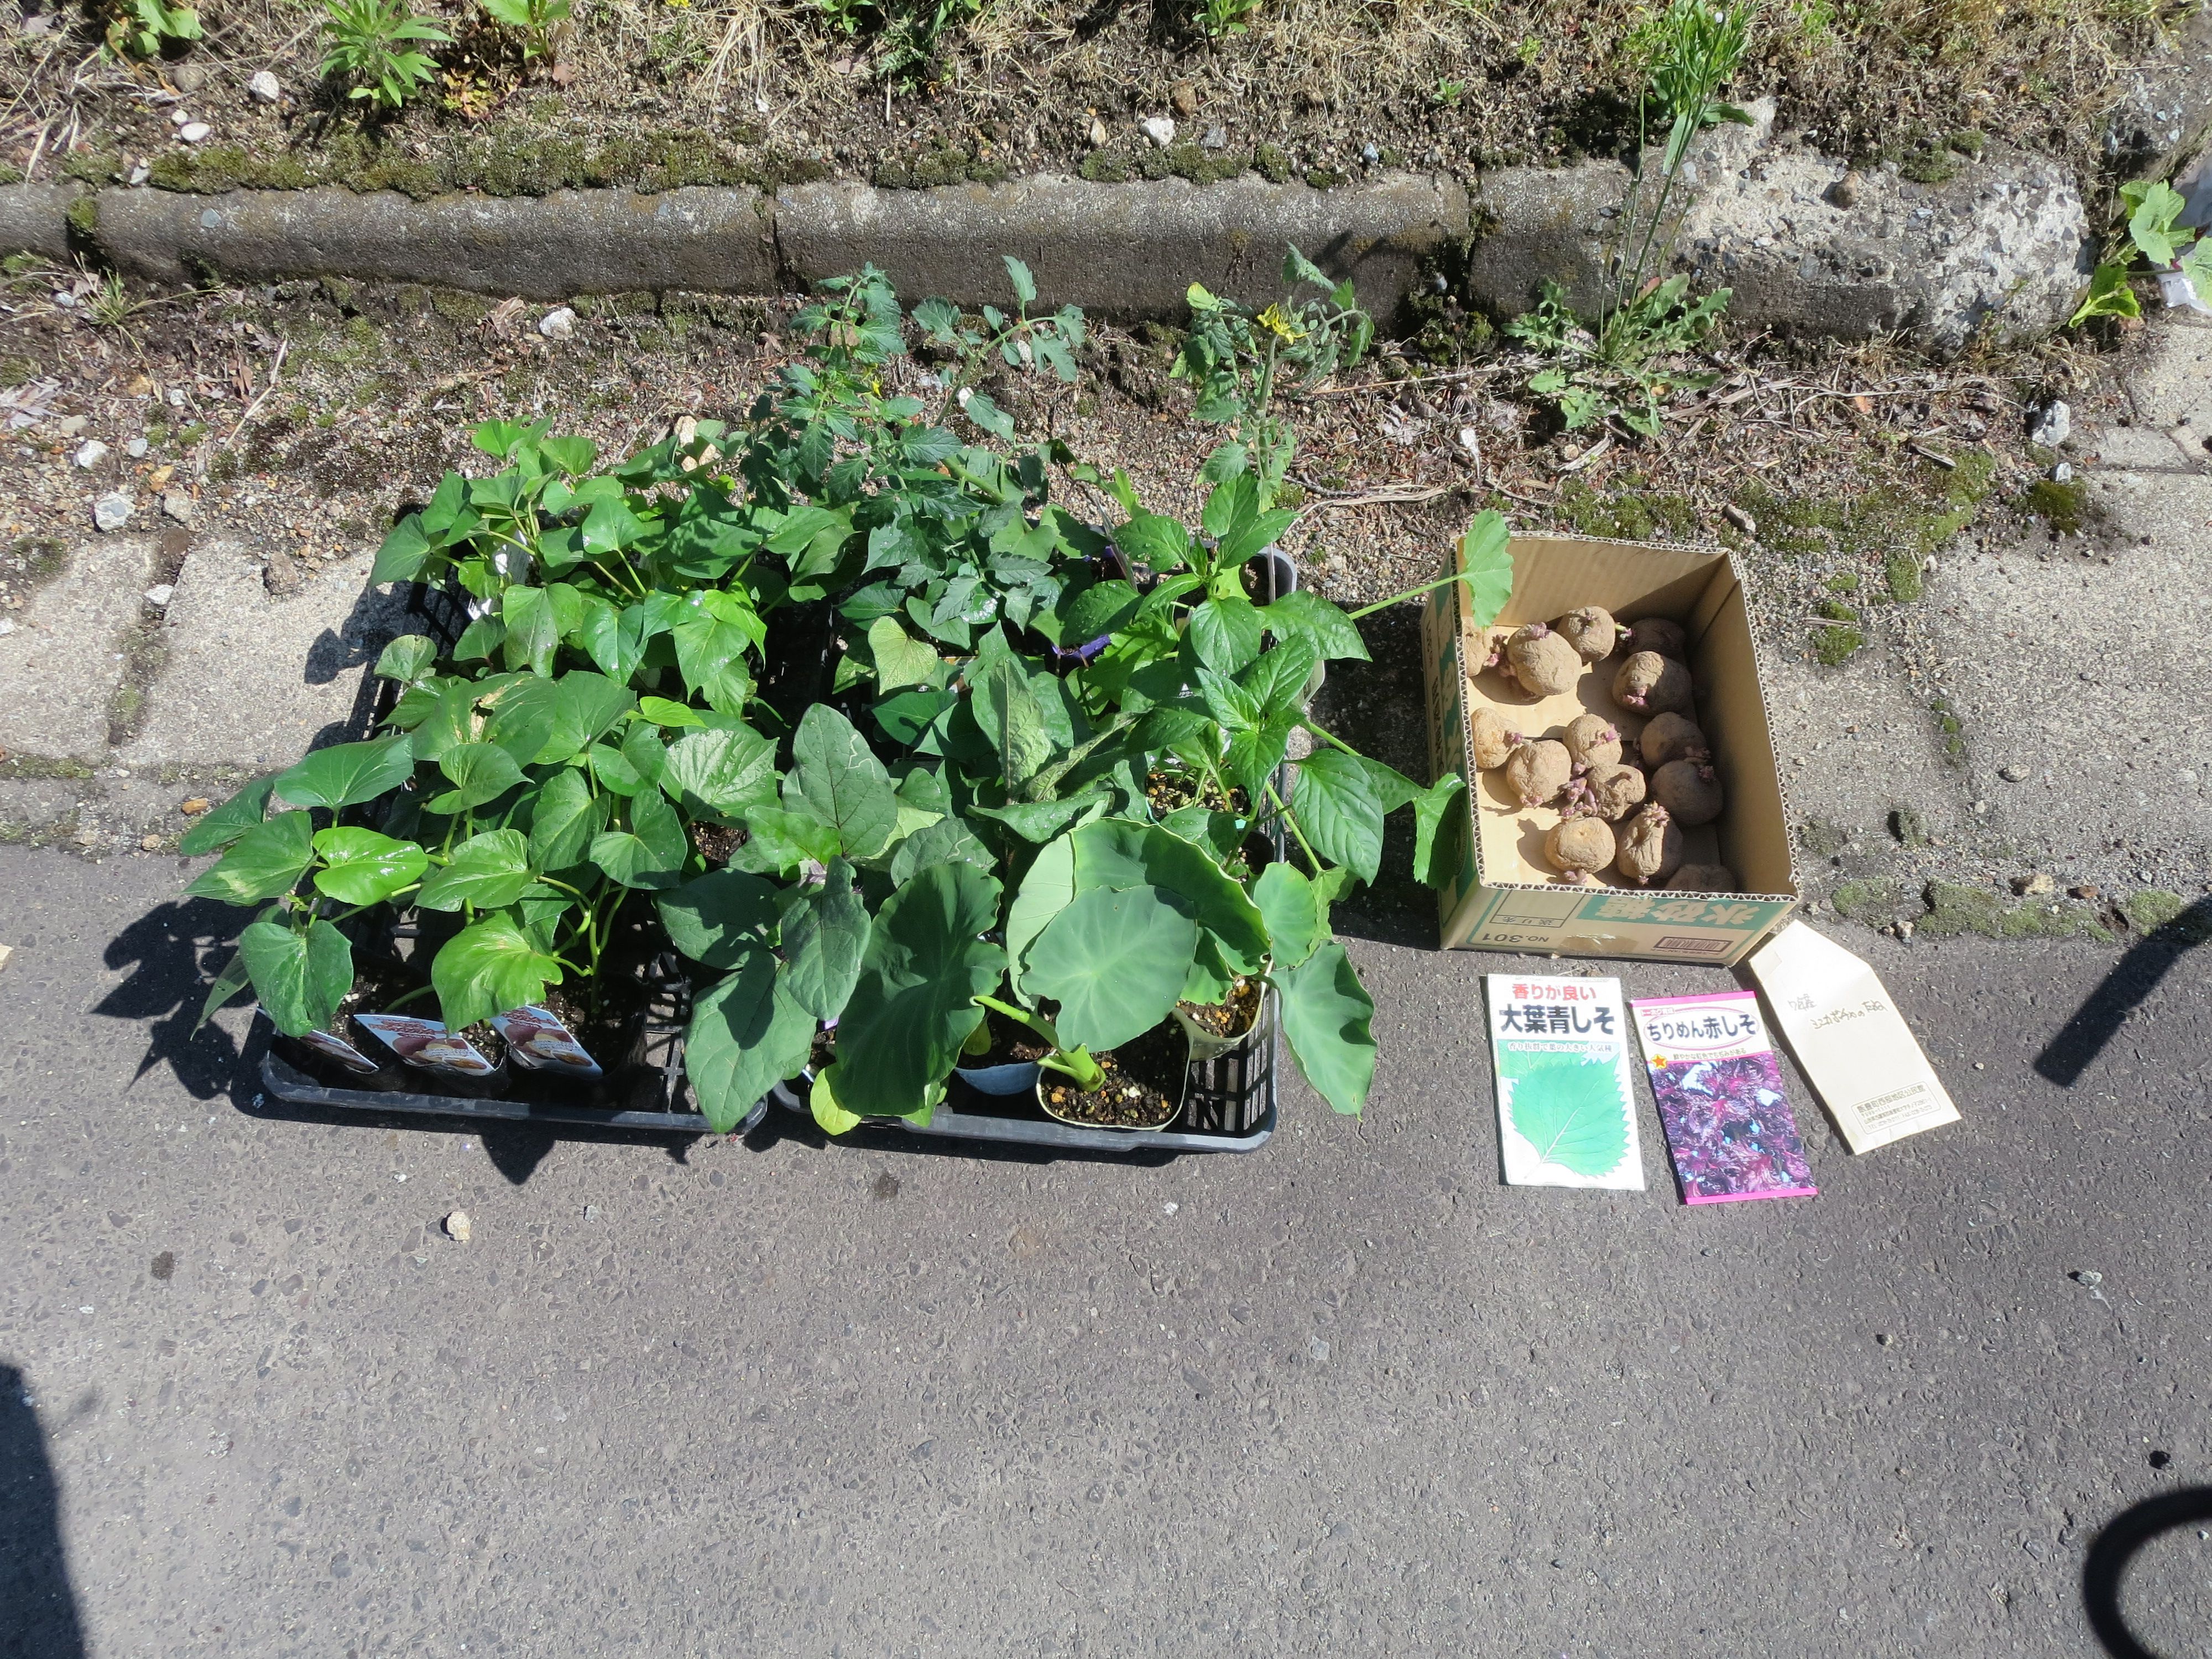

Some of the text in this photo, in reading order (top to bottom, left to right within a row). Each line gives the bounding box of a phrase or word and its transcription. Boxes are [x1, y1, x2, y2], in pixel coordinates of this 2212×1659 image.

[1503, 916, 1555, 926] 送り先
[1595, 896, 1760, 925] 氷砂糖
[1482, 933, 1550, 943] NO.301
[1512, 983, 1597, 1001] 香りが良い
[1499, 1003, 1615, 1035] 大葉青しそ
[1647, 1014, 1756, 1041] ちりめん赤しそ
